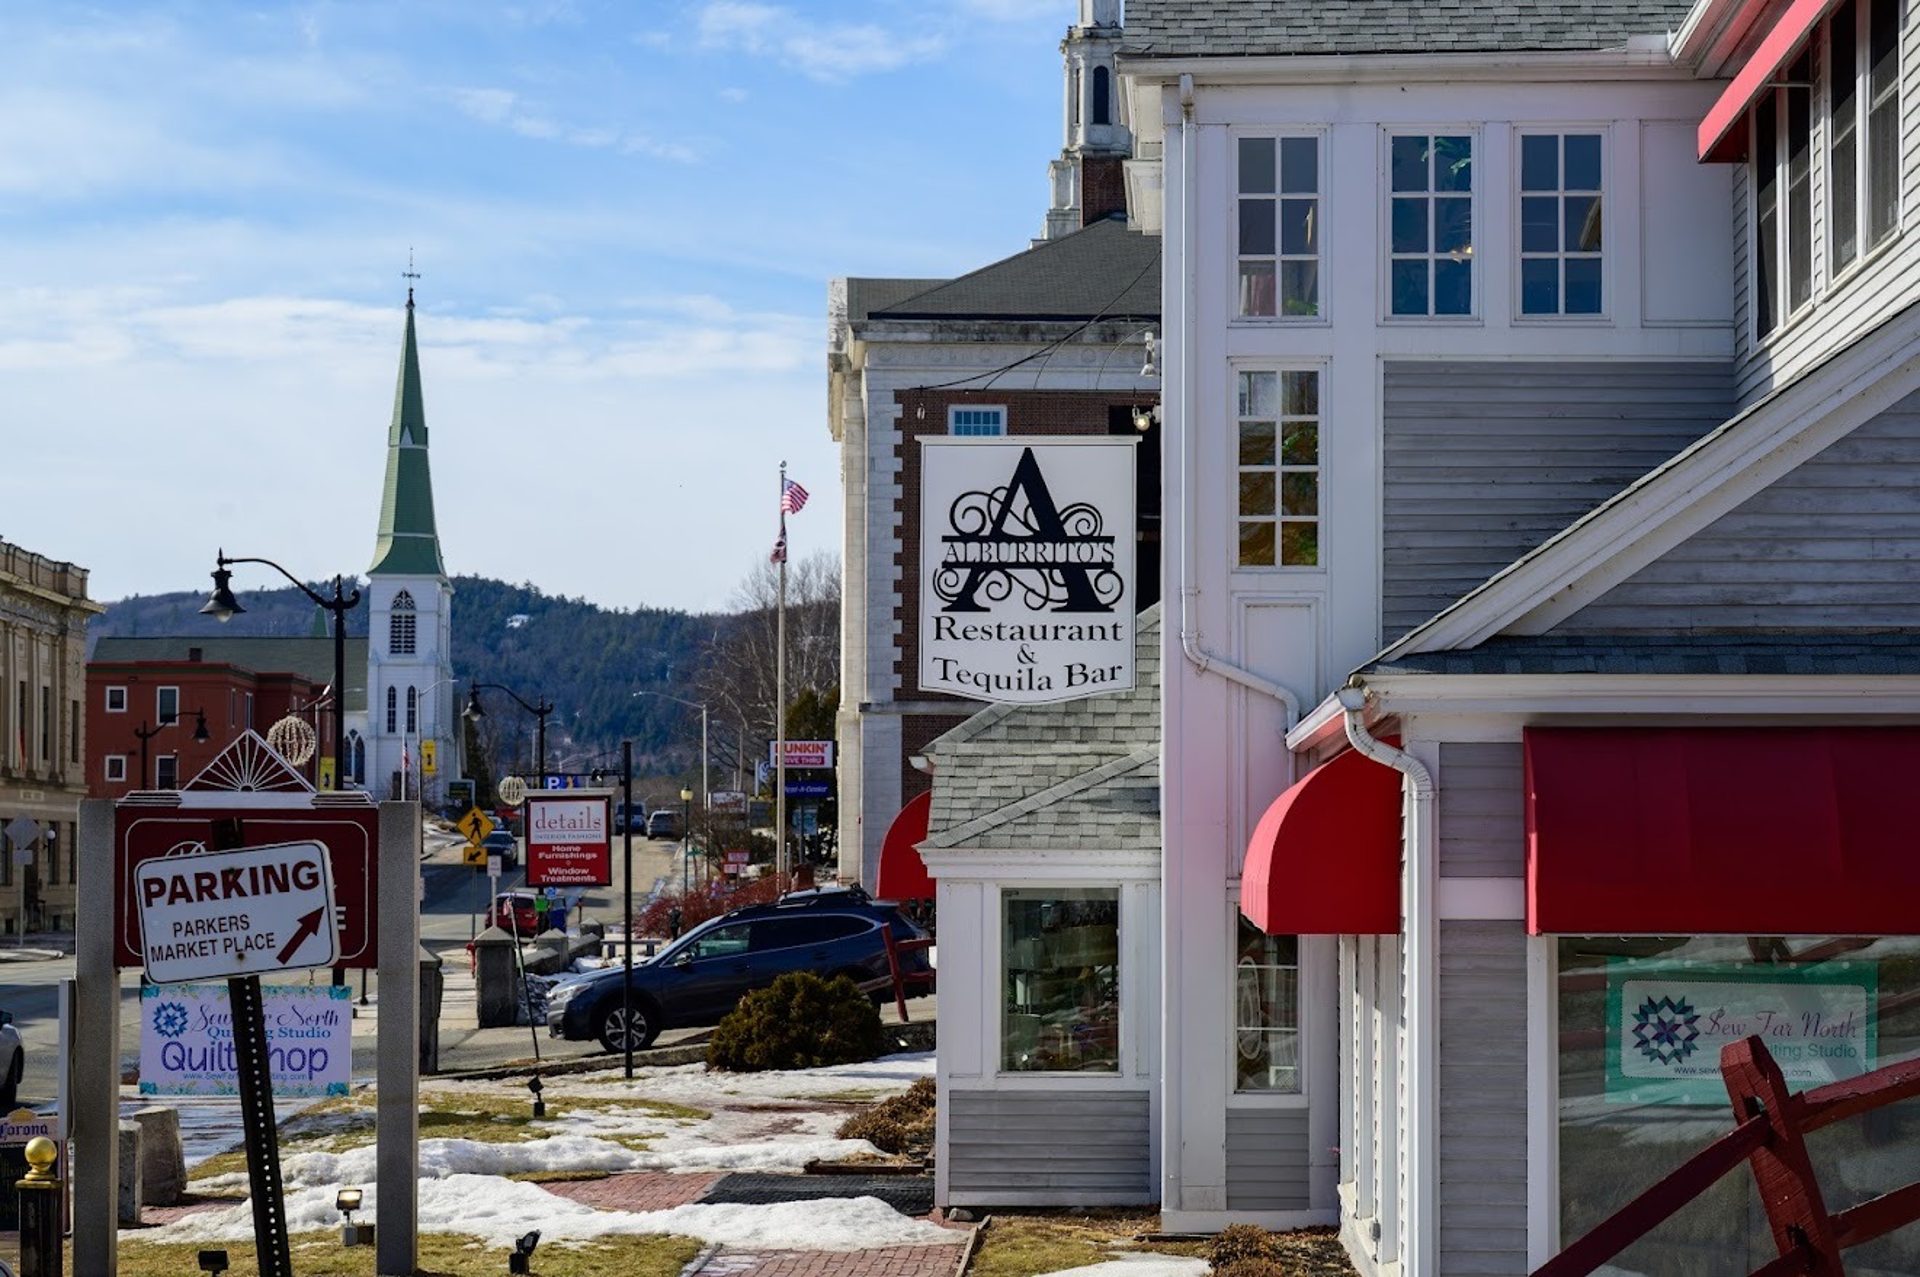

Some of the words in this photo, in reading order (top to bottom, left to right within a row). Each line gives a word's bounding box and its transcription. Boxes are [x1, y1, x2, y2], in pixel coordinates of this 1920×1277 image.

[932, 616, 1123, 641] Restaurant
[1017, 643, 1038, 664] &
[932, 657, 1053, 693] Tequila
[1064, 662, 1123, 688] Bar
[776, 743, 828, 754] UNKIN'
[535, 806, 601, 829] details
[538, 852, 598, 860] Furnishings
[540, 874, 597, 882] Treatments
[547, 867, 590, 875] Window
[143, 860, 320, 908] PARKING
[172, 914, 250, 938] PARKERS
[150, 940, 217, 962] MARKET
[223, 932, 276, 954] PLACE
[276, 1004, 339, 1027] North
[1704, 1006, 1747, 1036] Sew
[1755, 1010, 1793, 1037] Far
[1801, 1010, 1857, 1039] North
[277, 1026, 331, 1039] Studio
[160, 1040, 238, 1072] Quilt
[266, 1041, 329, 1081] hop
[1807, 1043, 1857, 1058] Studio
